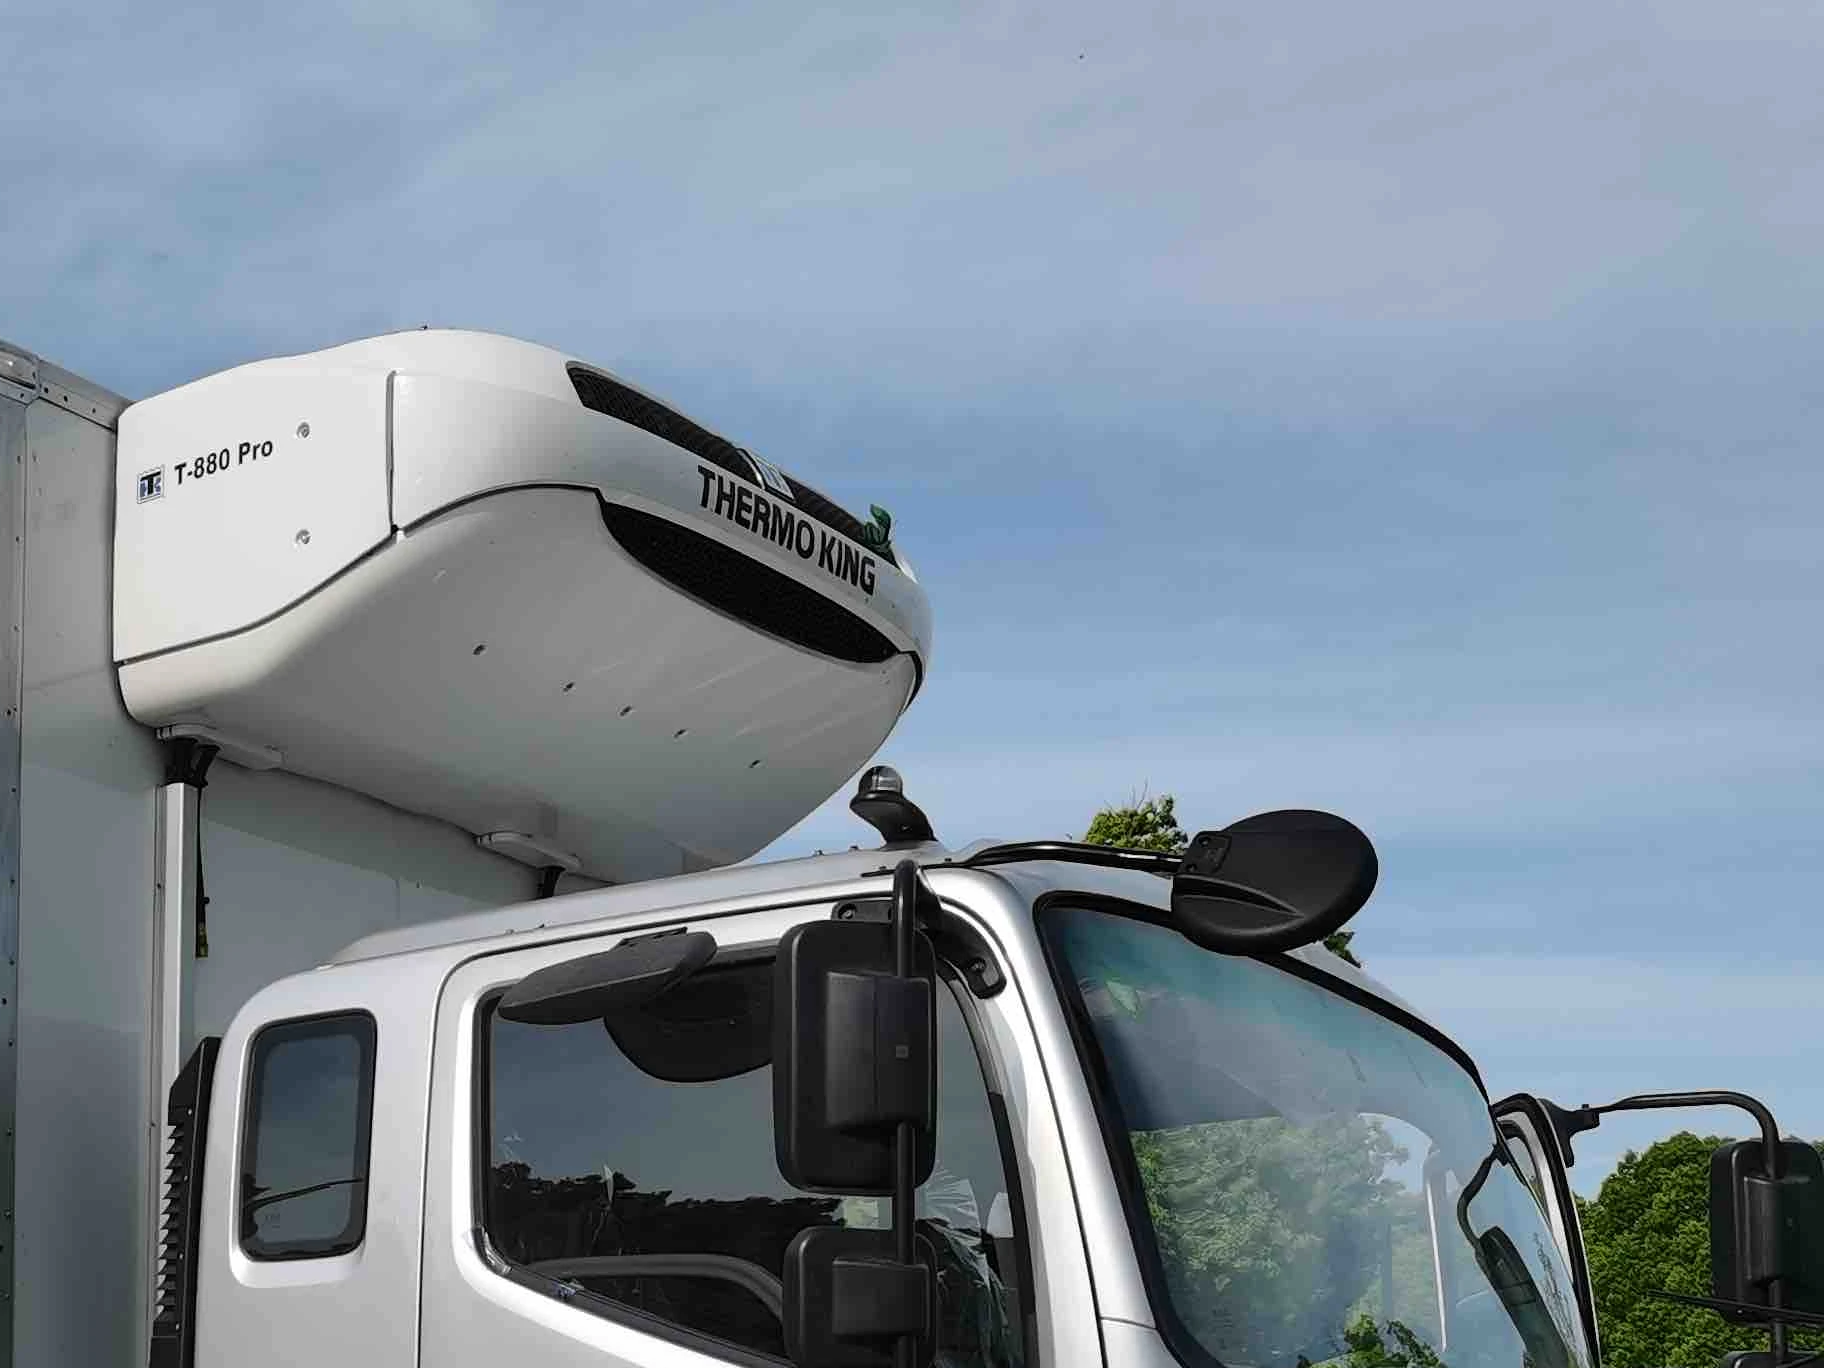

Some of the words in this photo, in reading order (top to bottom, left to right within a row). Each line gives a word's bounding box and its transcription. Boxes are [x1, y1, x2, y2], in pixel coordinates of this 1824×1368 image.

[174, 447, 230, 485] T-880
[238, 440, 274, 465] Pro
[697, 464, 815, 560] THERMO
[817, 529, 876, 596] KING
